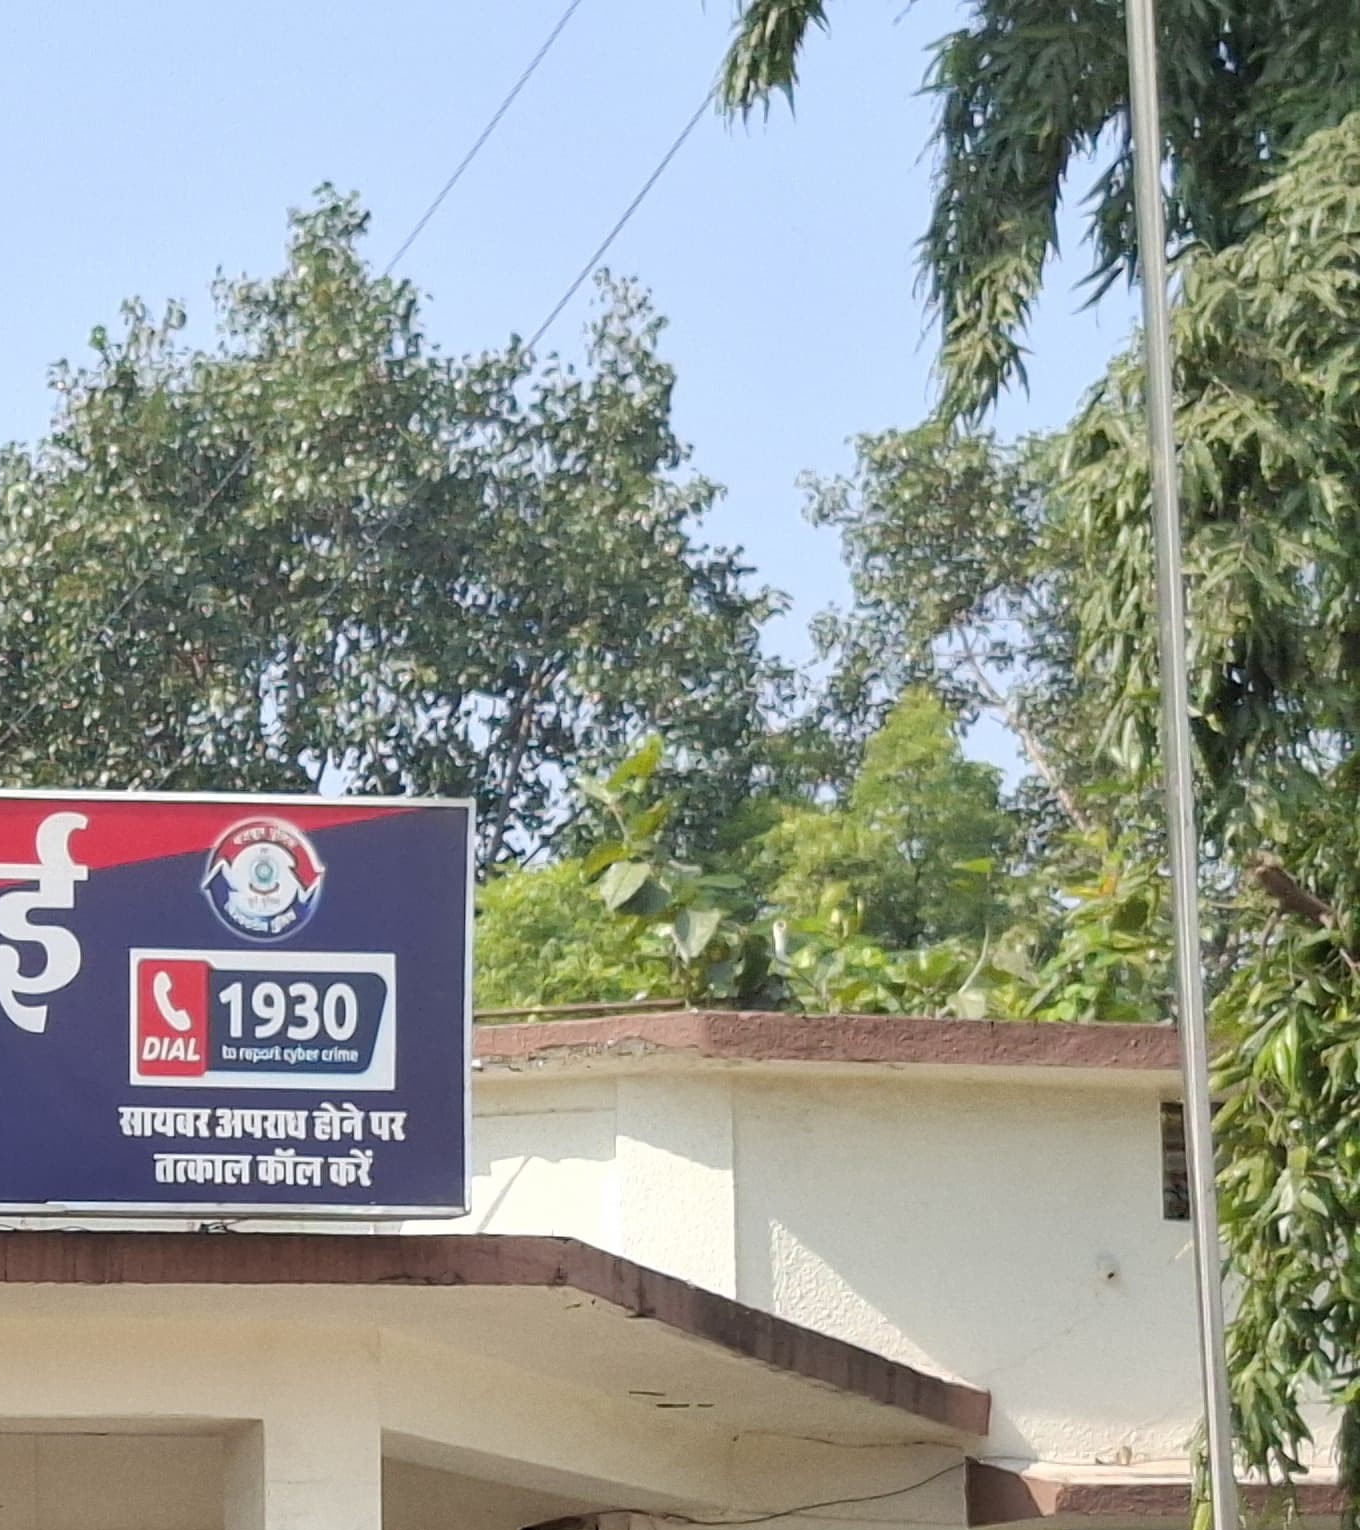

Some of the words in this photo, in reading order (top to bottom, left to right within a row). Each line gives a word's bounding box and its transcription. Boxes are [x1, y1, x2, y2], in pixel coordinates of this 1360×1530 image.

[218, 981, 358, 1041] 1930
[142, 1036, 201, 1062] DIAL
[221, 1045, 236, 1060] to
[239, 1045, 282, 1063] report
[283, 1044, 319, 1065] cyber
[322, 1046, 359, 1063] crime
[215, 1108, 310, 1140] अपराध
[312, 1101, 365, 1141] होने
[369, 1111, 408, 1141] पर
[153, 1153, 253, 1184] तत्काल
[256, 1148, 324, 1186] कॉल
[327, 1149, 374, 1187] करें
